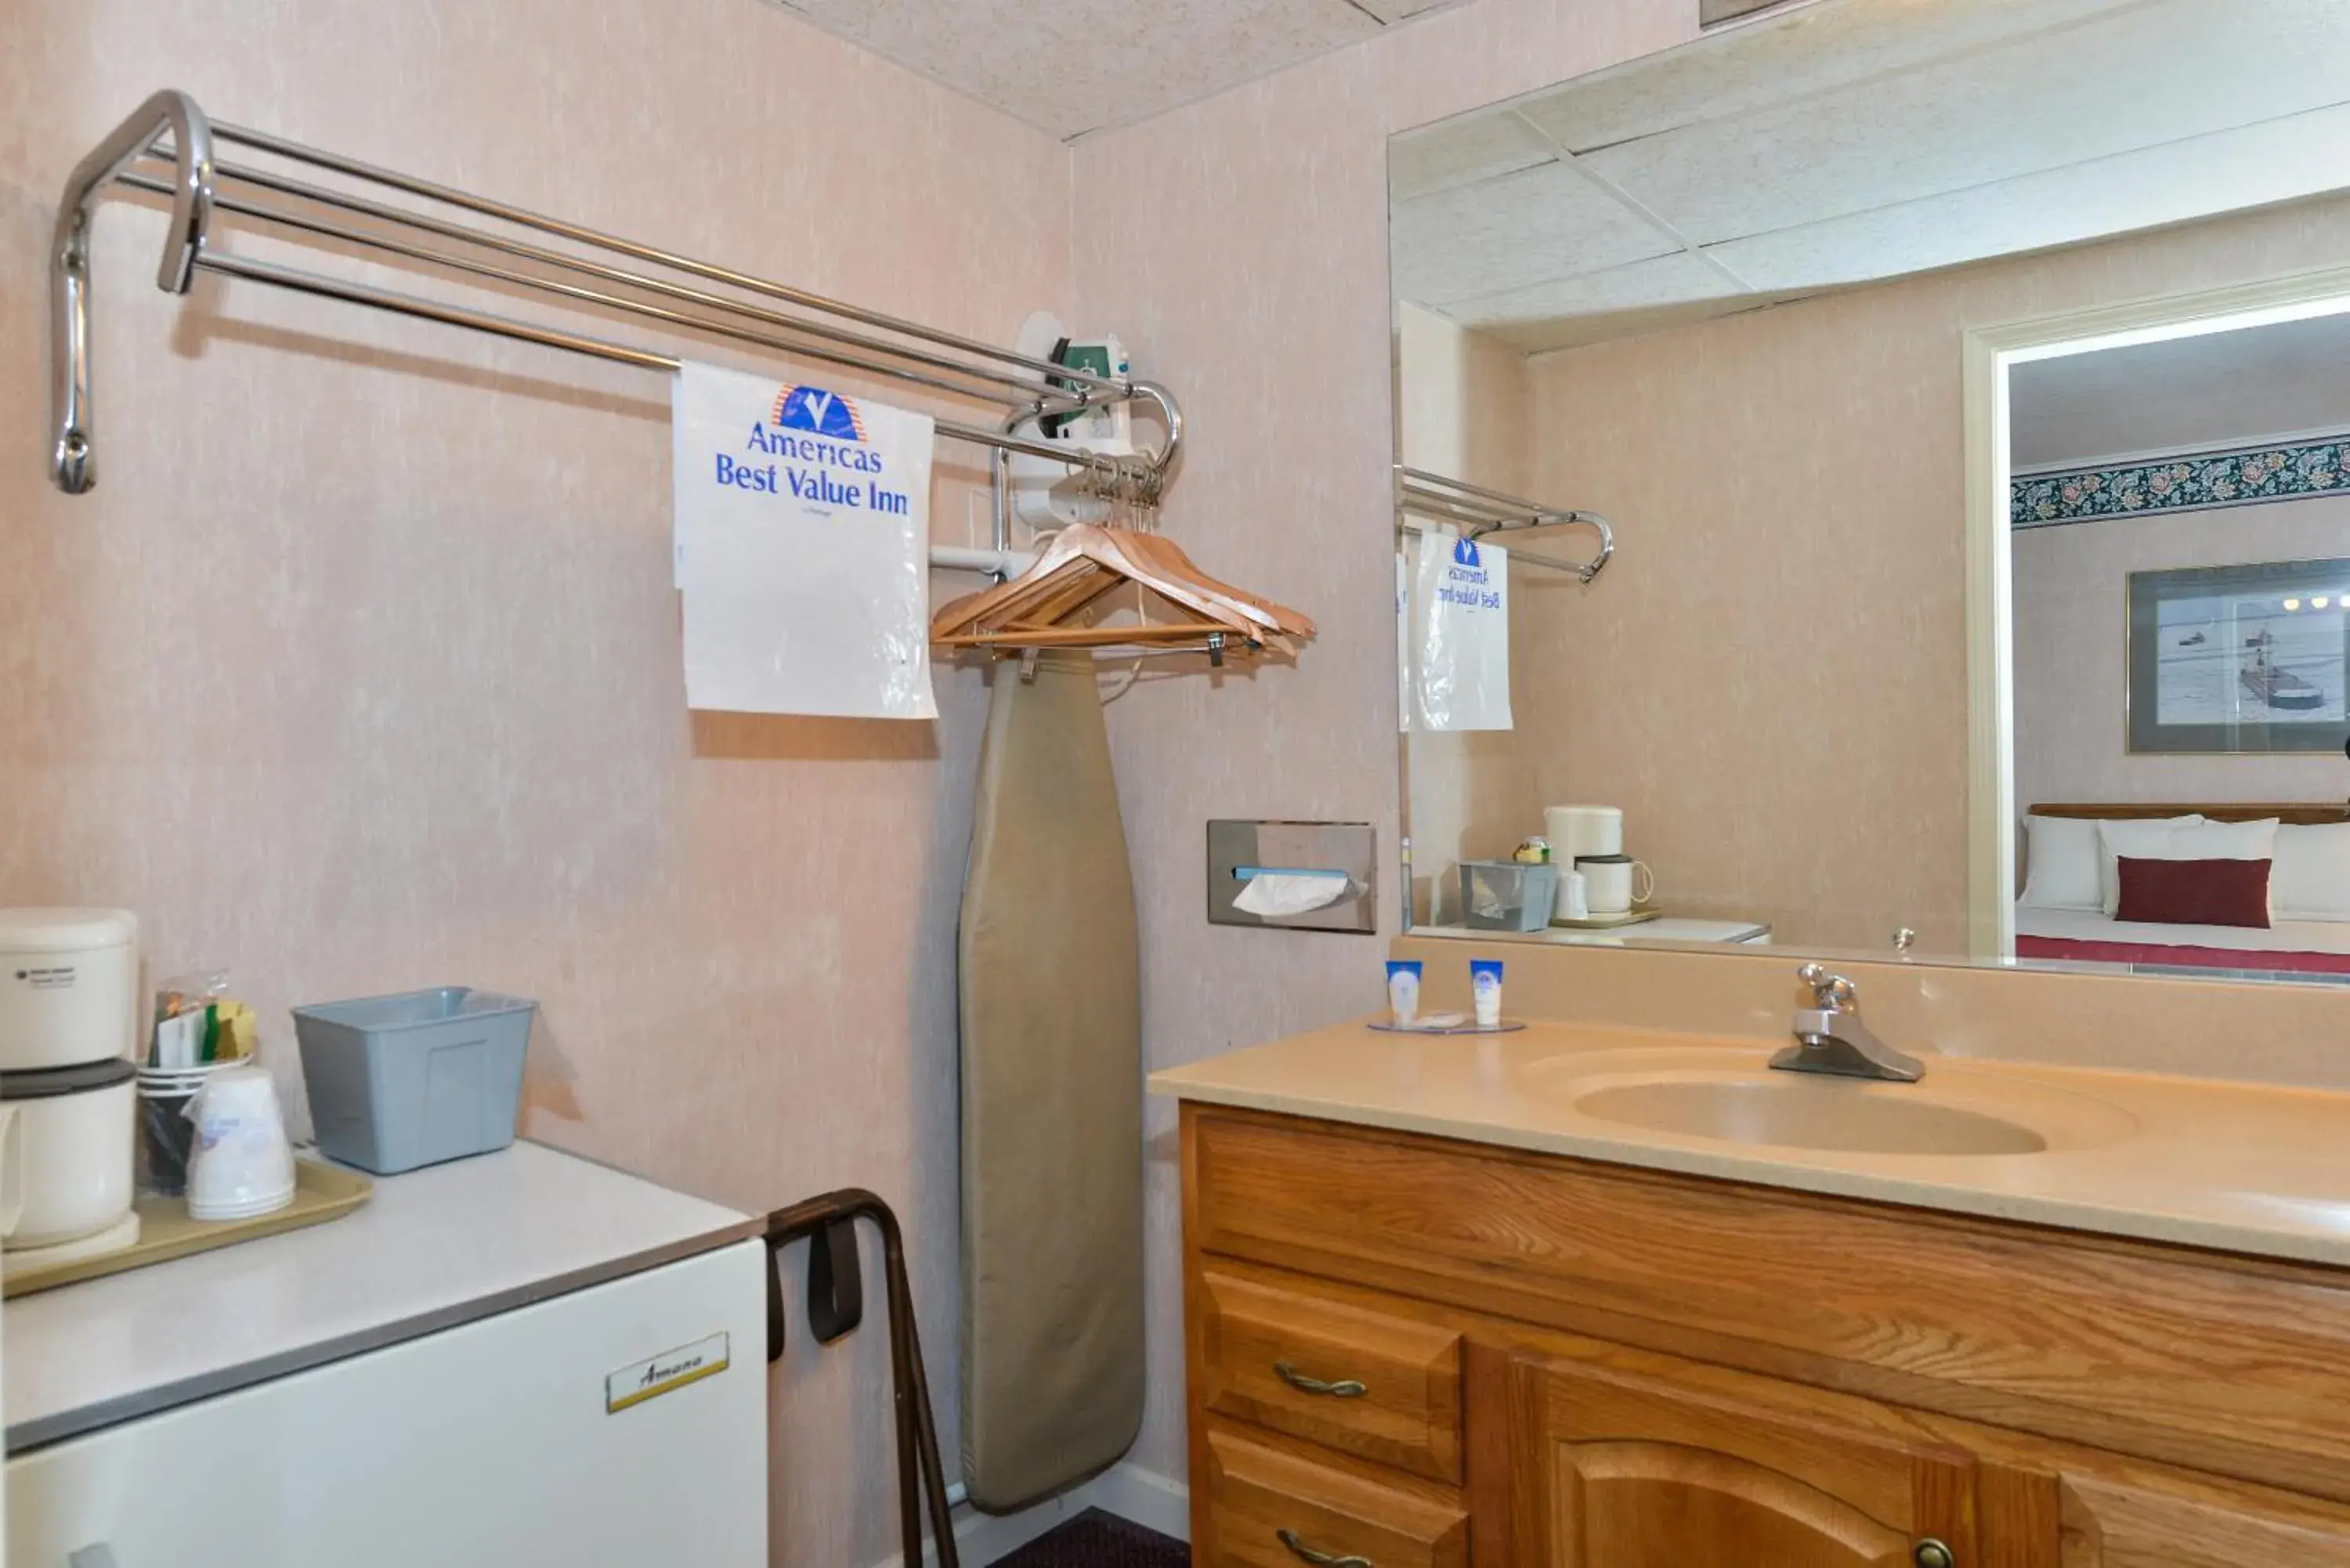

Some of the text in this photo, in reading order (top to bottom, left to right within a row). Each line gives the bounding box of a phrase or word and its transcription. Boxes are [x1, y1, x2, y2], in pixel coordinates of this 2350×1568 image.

[747, 421, 883, 474] Americas
[716, 453, 909, 515] Best Value Inn
[639, 1356, 703, 1388] Amana
